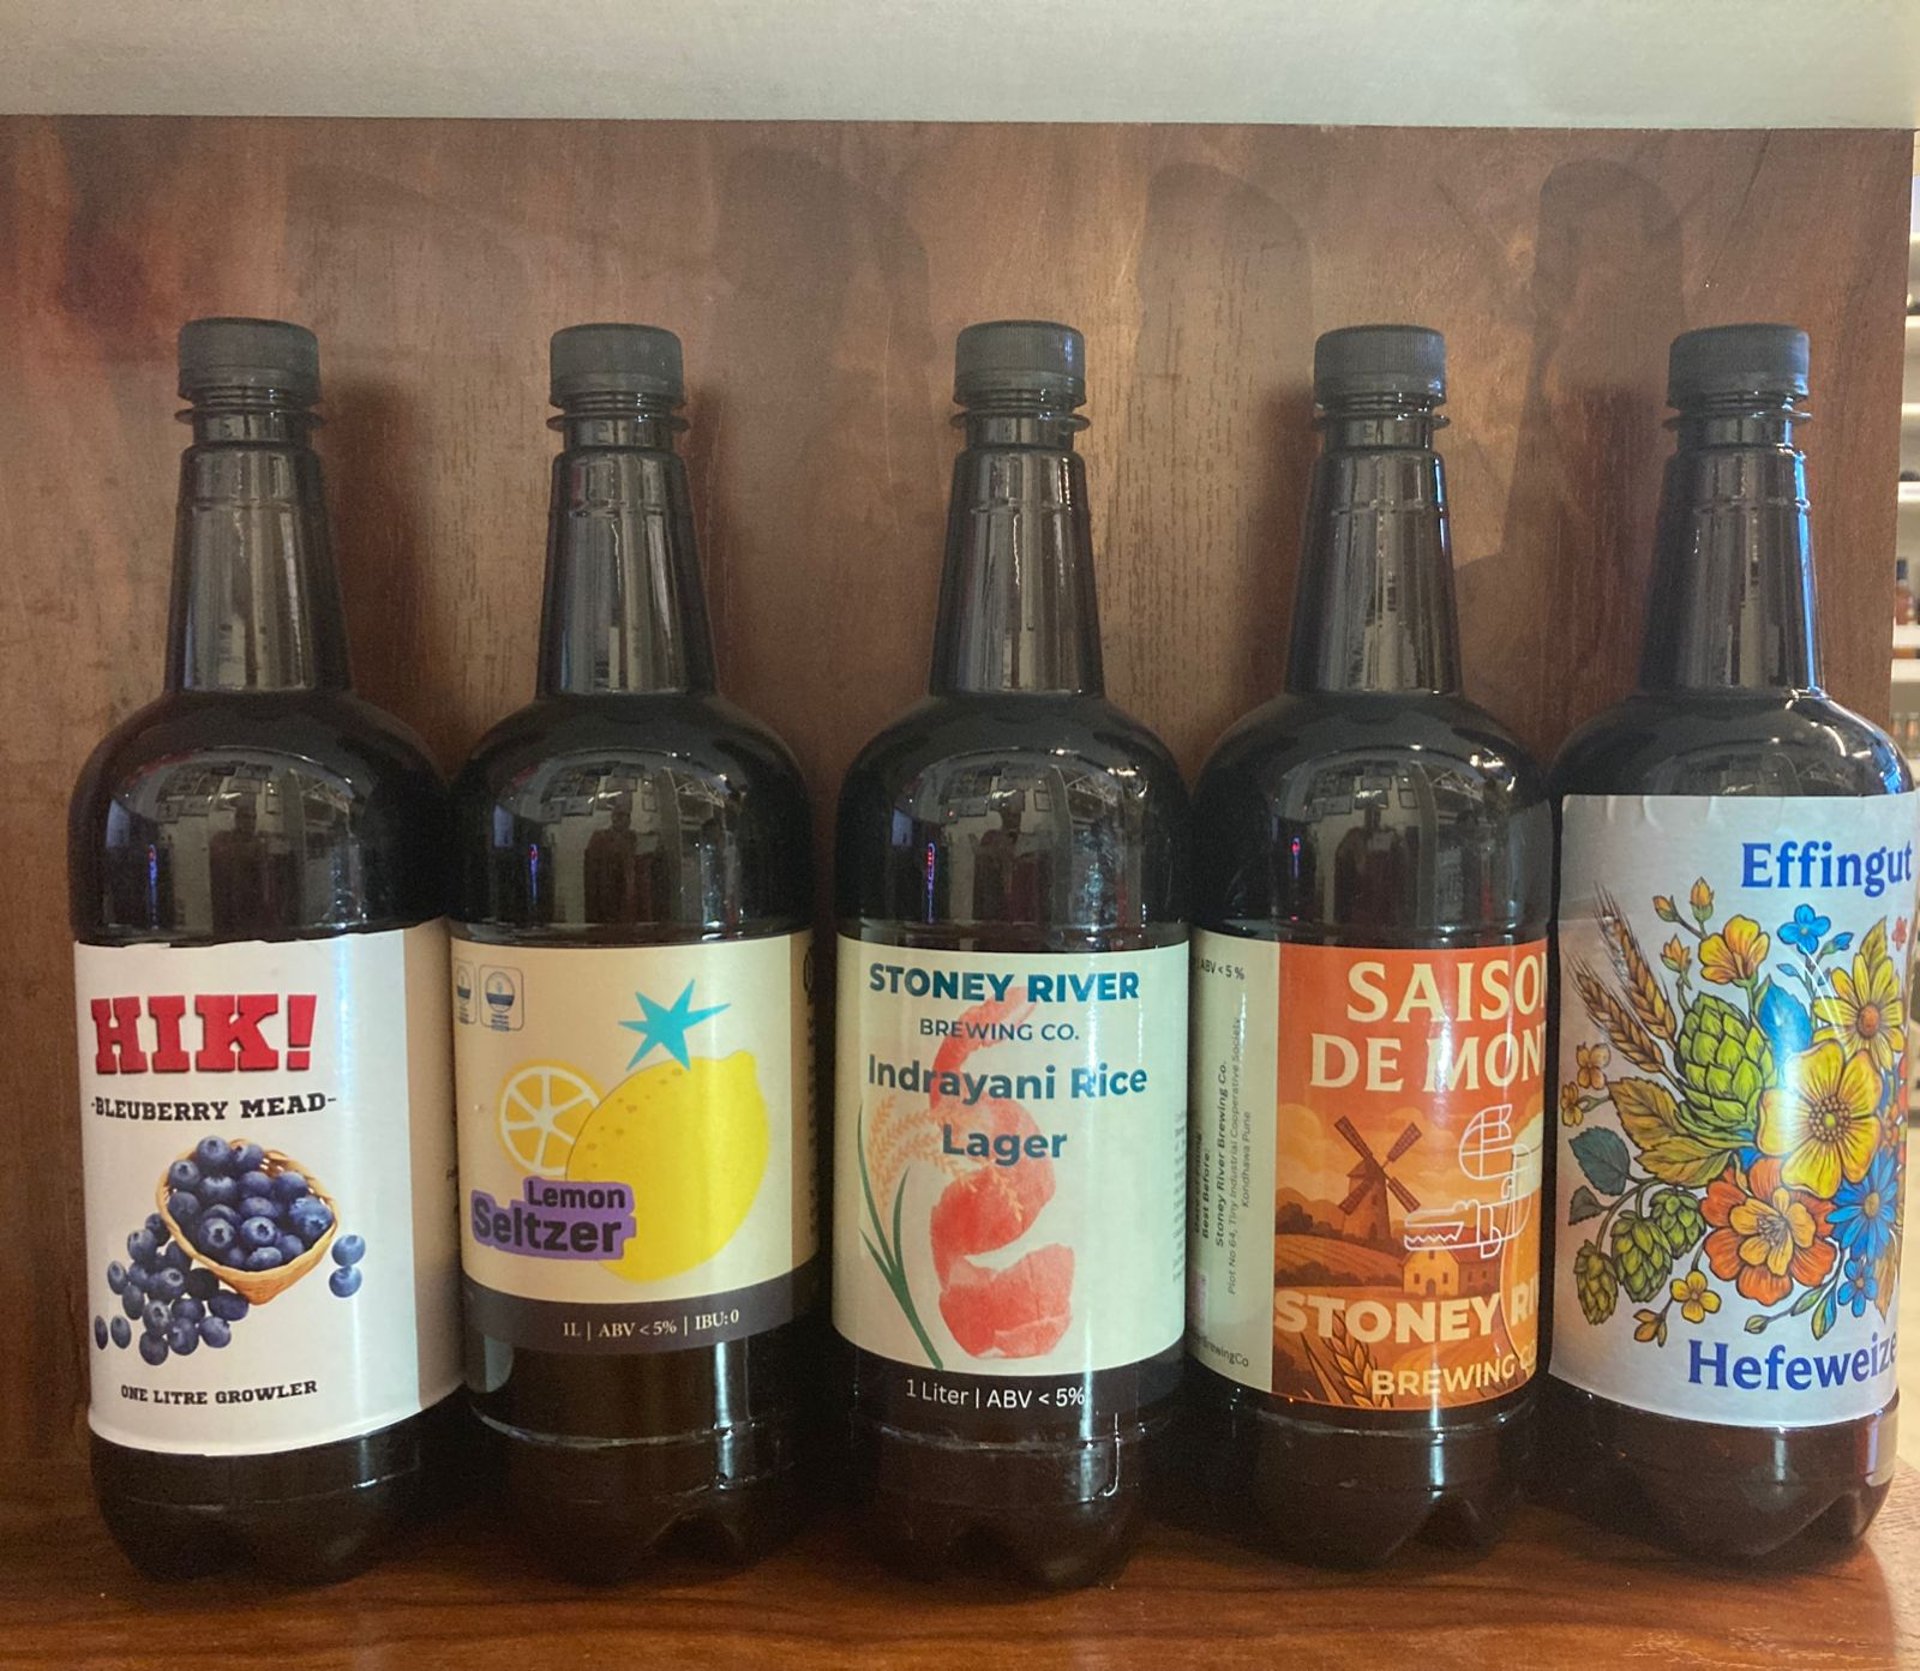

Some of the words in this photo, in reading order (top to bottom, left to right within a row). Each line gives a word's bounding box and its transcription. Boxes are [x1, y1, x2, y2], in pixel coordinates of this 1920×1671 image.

[1741, 840, 1912, 898] Effingut
[870, 963, 1015, 1001] STONEY
[1027, 972, 1139, 1002] RIVER
[91, 994, 317, 1075] HIK!
[920, 1018, 1032, 1041] BREWING
[1041, 1023, 1079, 1041] CO.
[869, 1055, 1056, 1105] Indrayani
[1071, 1063, 1147, 1098] Rice
[1217, 1060, 1227, 1085] Co.
[1310, 1033, 1404, 1092] DE
[1216, 1088, 1228, 1149] Brewing
[1230, 1065, 1241, 1138] Cooperative
[943, 1124, 1067, 1167] Lager
[1241, 1111, 1251, 1142] Pune
[1215, 1151, 1226, 1191] River
[1229, 1140, 1239, 1198] Industrial
[527, 1180, 626, 1209] Lemon
[1228, 1200, 1240, 1226] Tiny
[473, 1197, 622, 1253] Seltzer
[1214, 1193, 1227, 1248] Stoney
[1228, 1250, 1237, 1268] No
[1227, 1270, 1237, 1295] Plot
[598, 1322, 636, 1338] ABV
[1274, 1290, 1501, 1343] STONEY
[121, 1384, 149, 1402] ONE
[153, 1389, 208, 1405] LITRE
[215, 1380, 318, 1404] GROWLER
[906, 1379, 916, 1397] 1
[922, 1381, 969, 1405] Liter
[986, 1389, 1033, 1408] ABV
[1373, 1353, 1516, 1397] BREWING
